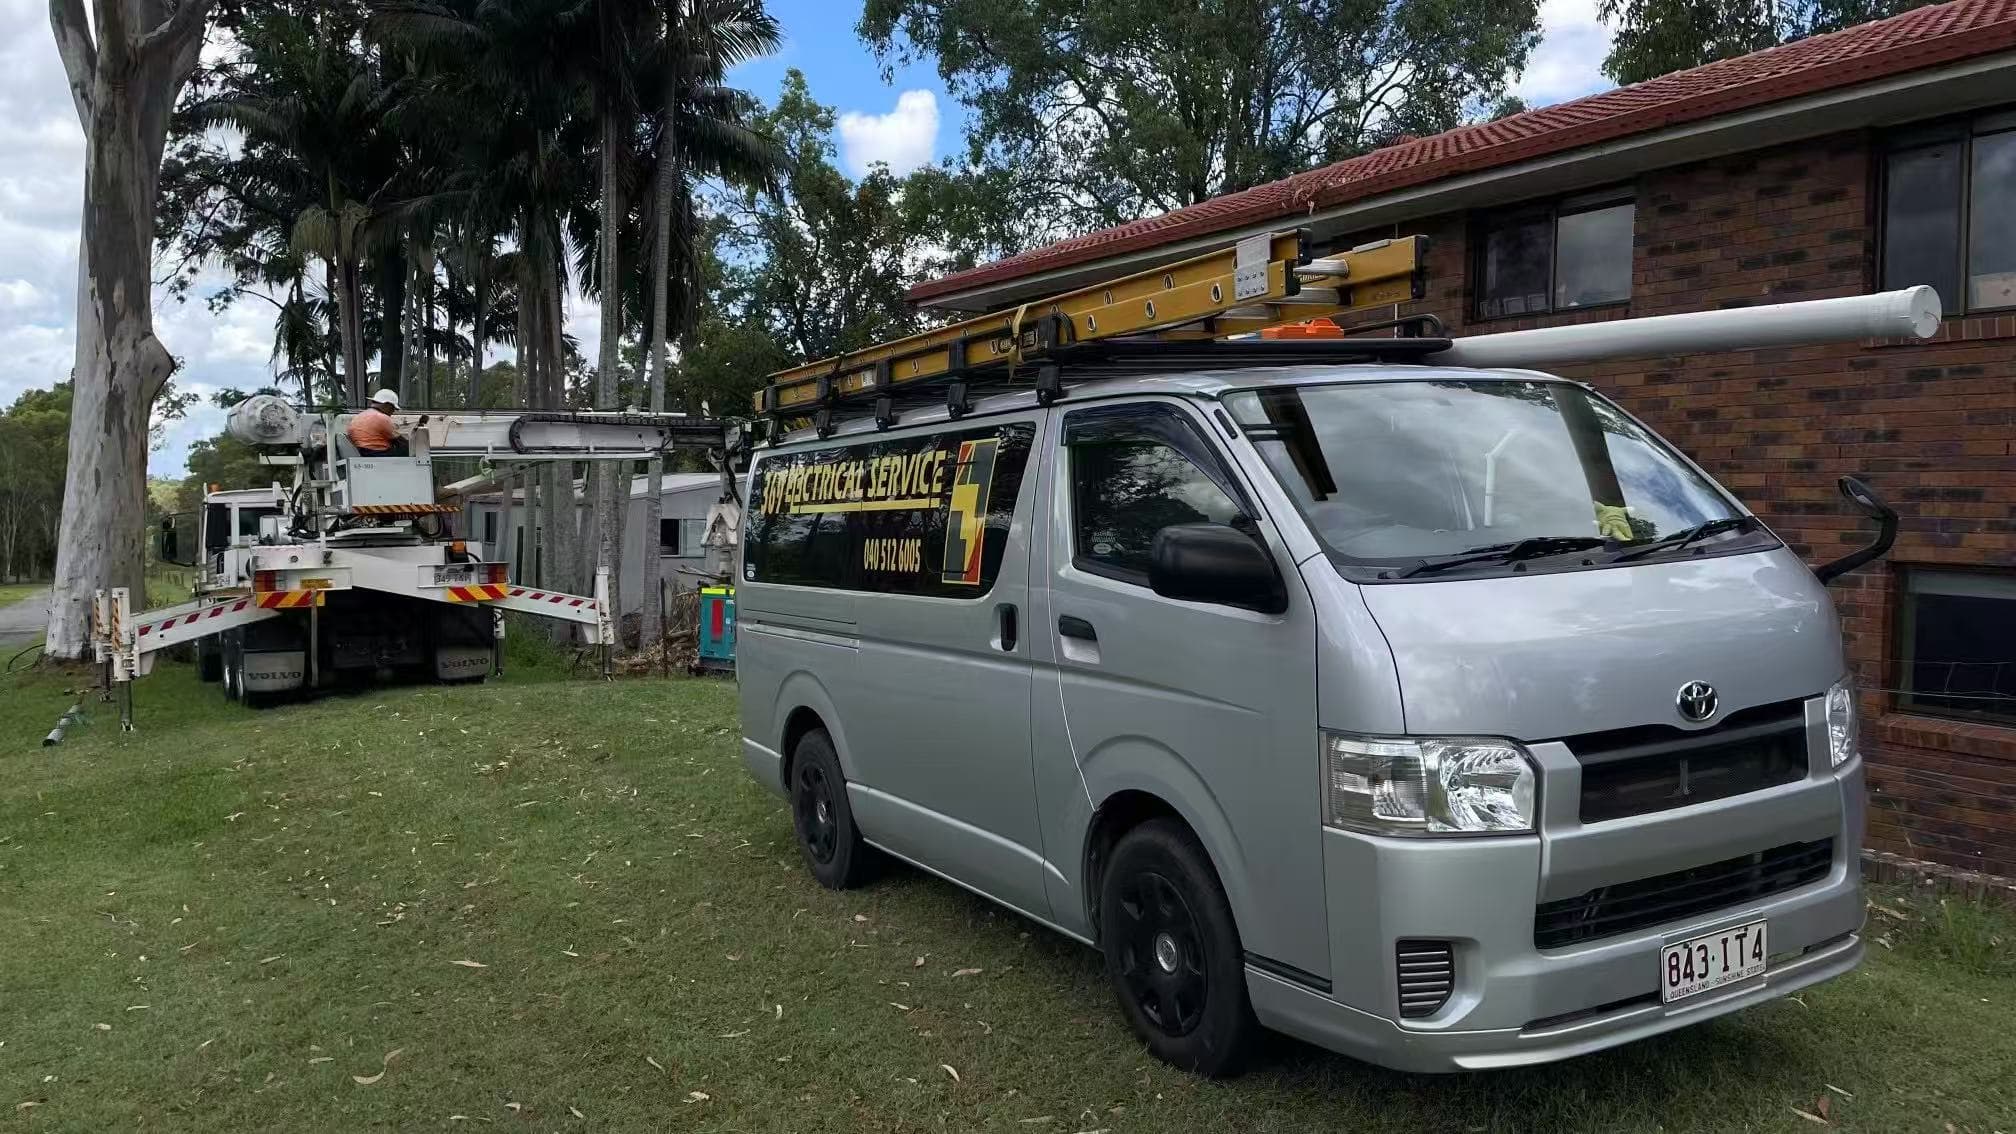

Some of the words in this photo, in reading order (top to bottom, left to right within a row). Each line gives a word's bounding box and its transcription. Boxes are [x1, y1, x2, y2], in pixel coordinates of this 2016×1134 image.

[785, 460, 864, 504] ELECTRICAL
[868, 450, 947, 498] SERVICE
[863, 538, 880, 571] 040
[880, 538, 897, 571] 512
[898, 538, 921, 573] 6005
[440, 657, 489, 669] VOLVO
[248, 671, 302, 681] VOLVO
